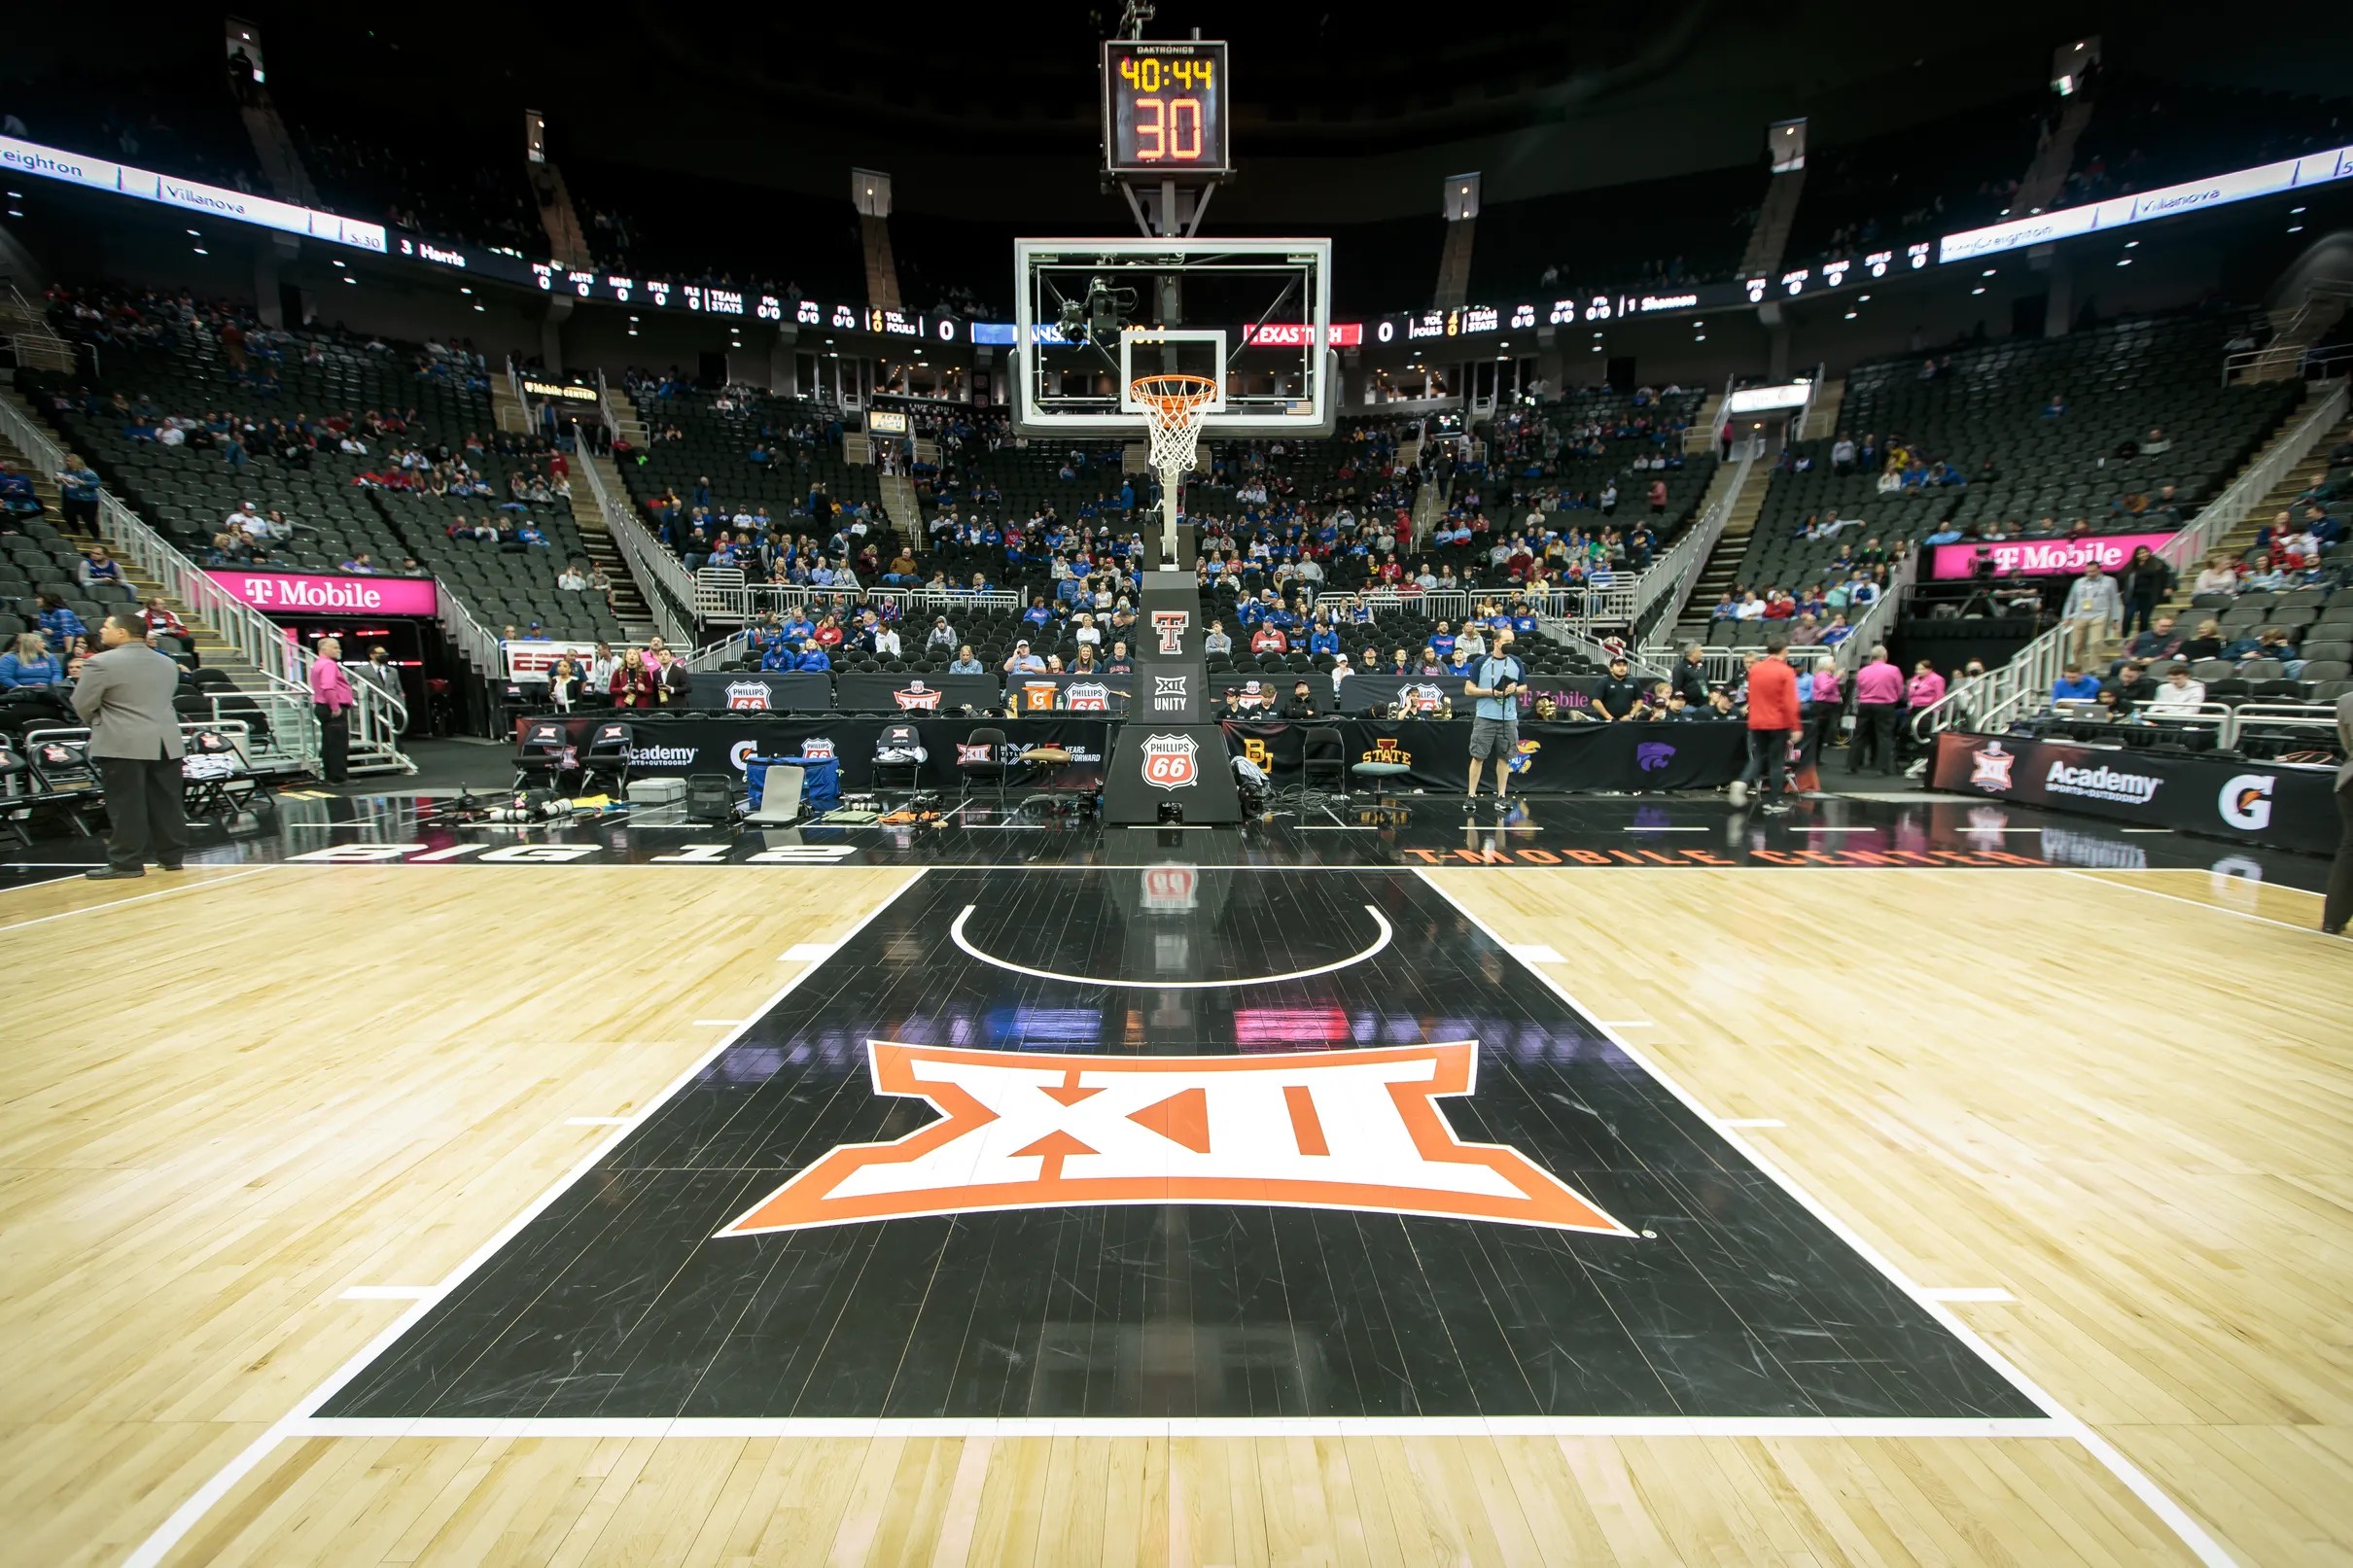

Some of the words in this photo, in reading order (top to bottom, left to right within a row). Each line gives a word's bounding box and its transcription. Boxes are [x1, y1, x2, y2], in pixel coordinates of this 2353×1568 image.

[1137, 47, 1195, 55] DAKTRONICS
[1120, 58, 1212, 92] 40:44
[1136, 98, 1202, 159] 30
[166, 185, 245, 214] Villanova
[2141, 190, 2221, 212] Villanova
[350, 233, 380, 249] 5:30
[401, 239, 412, 254] 3
[419, 243, 466, 267] Harris
[1912, 254, 1927, 269] 0
[1872, 262, 1887, 278] 0
[539, 275, 550, 290] 0
[1829, 271, 1843, 287] 0
[578, 283, 589, 296] 0
[617, 288, 629, 301] 0
[647, 281, 670, 294] STLS
[1789, 281, 1803, 296] 0
[654, 293, 666, 305] 0
[688, 296, 700, 310] 0
[711, 290, 742, 303] TEAM
[1750, 289, 1763, 302] 0
[712, 301, 743, 314] STATS
[1628, 298, 1636, 311] 1
[757, 305, 781, 320] 0/0
[797, 310, 820, 324] 0/0
[872, 309, 883, 321] 4
[885, 312, 904, 324] TOL
[1468, 309, 1497, 322] TEAM
[1550, 309, 1574, 325] 0/0
[1586, 305, 1611, 321] 0/0
[832, 314, 855, 329] 0/0
[872, 321, 883, 332] 0
[886, 322, 916, 334] FOULS
[1423, 316, 1443, 327] TOL
[1467, 320, 1497, 332] STATS
[1511, 314, 1535, 329] 0/0
[939, 320, 955, 341] 0
[1378, 322, 1393, 342] 0
[1414, 326, 1443, 337] FOULS
[1447, 324, 1458, 336] 0
[2022, 541, 2122, 571] Mobile
[278, 580, 381, 609] Mobile
[1033, 692, 1046, 706] G
[1071, 689, 1104, 698] PHILLIPS
[1154, 697, 1187, 712] UNITY
[1065, 746, 1085, 754] YEARS
[1150, 743, 1190, 752] PHILLIPS
[1362, 749, 1412, 766] STATE
[1152, 757, 1187, 778] 66
[2046, 761, 2160, 802] Academy
[2219, 775, 2277, 830] G
[284, 844, 603, 861] BIG
[650, 845, 858, 862] 12
[1404, 849, 1737, 864] T-MOBILE
[1750, 851, 2052, 865] CENTER
[821, 1057, 1533, 1202] XII
